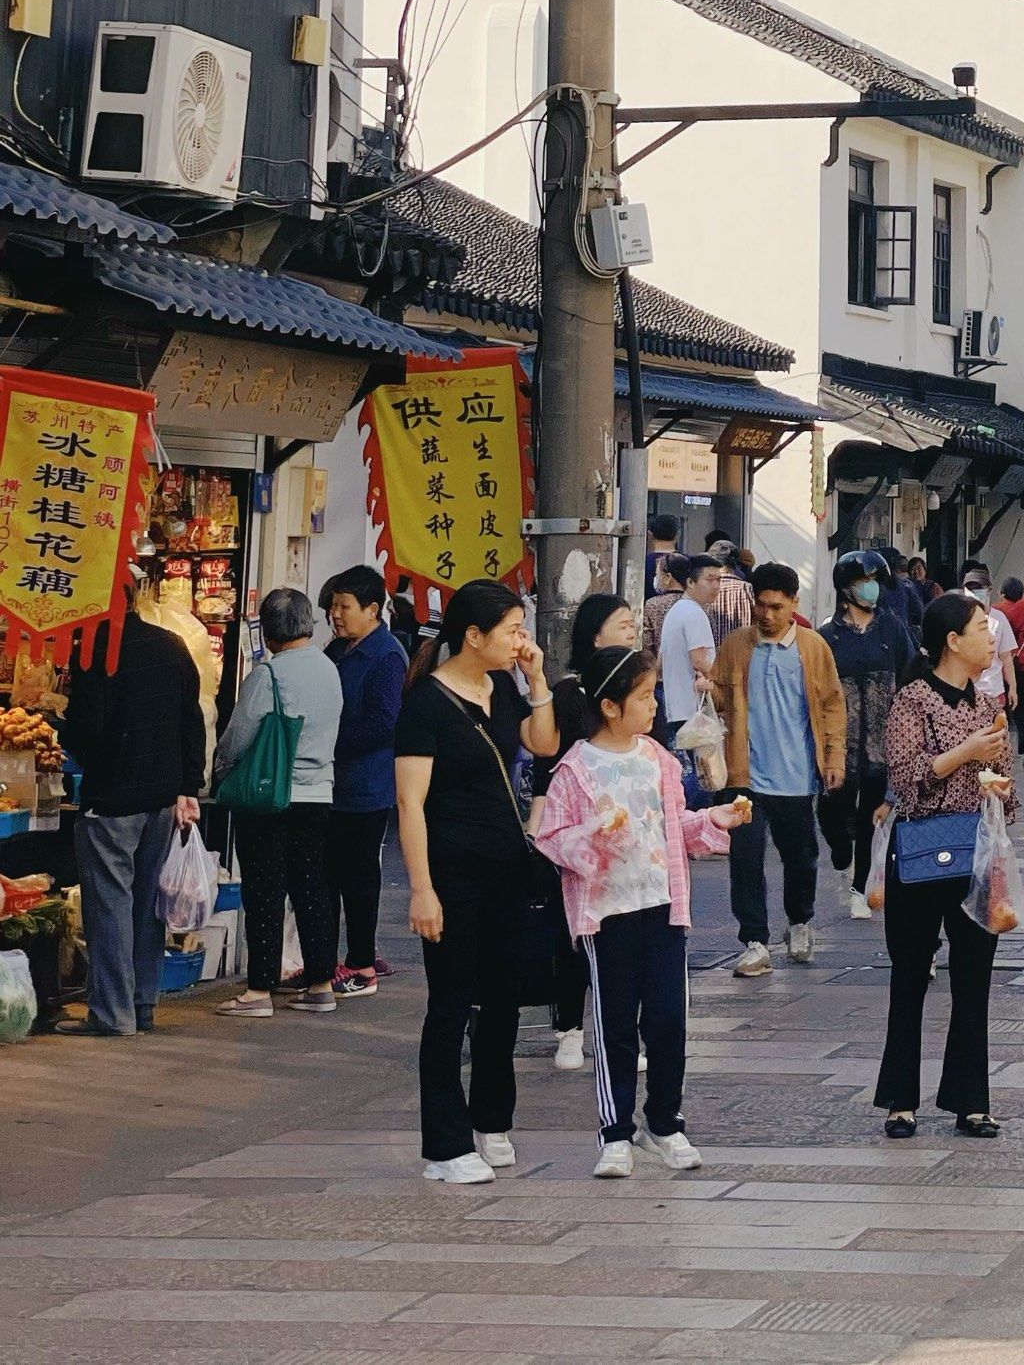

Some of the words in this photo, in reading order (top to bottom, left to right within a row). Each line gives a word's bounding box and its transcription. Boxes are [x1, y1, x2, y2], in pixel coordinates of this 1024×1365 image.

[22, 409, 125, 437] 苏州特产
[392, 392, 505, 430] 供应
[16, 432, 97, 598] 冰糖桂花藕
[93, 456, 126, 530] 顾阿姨
[421, 436, 456, 579] 蔬菜种子
[472, 433, 503, 577] 生面皮子
